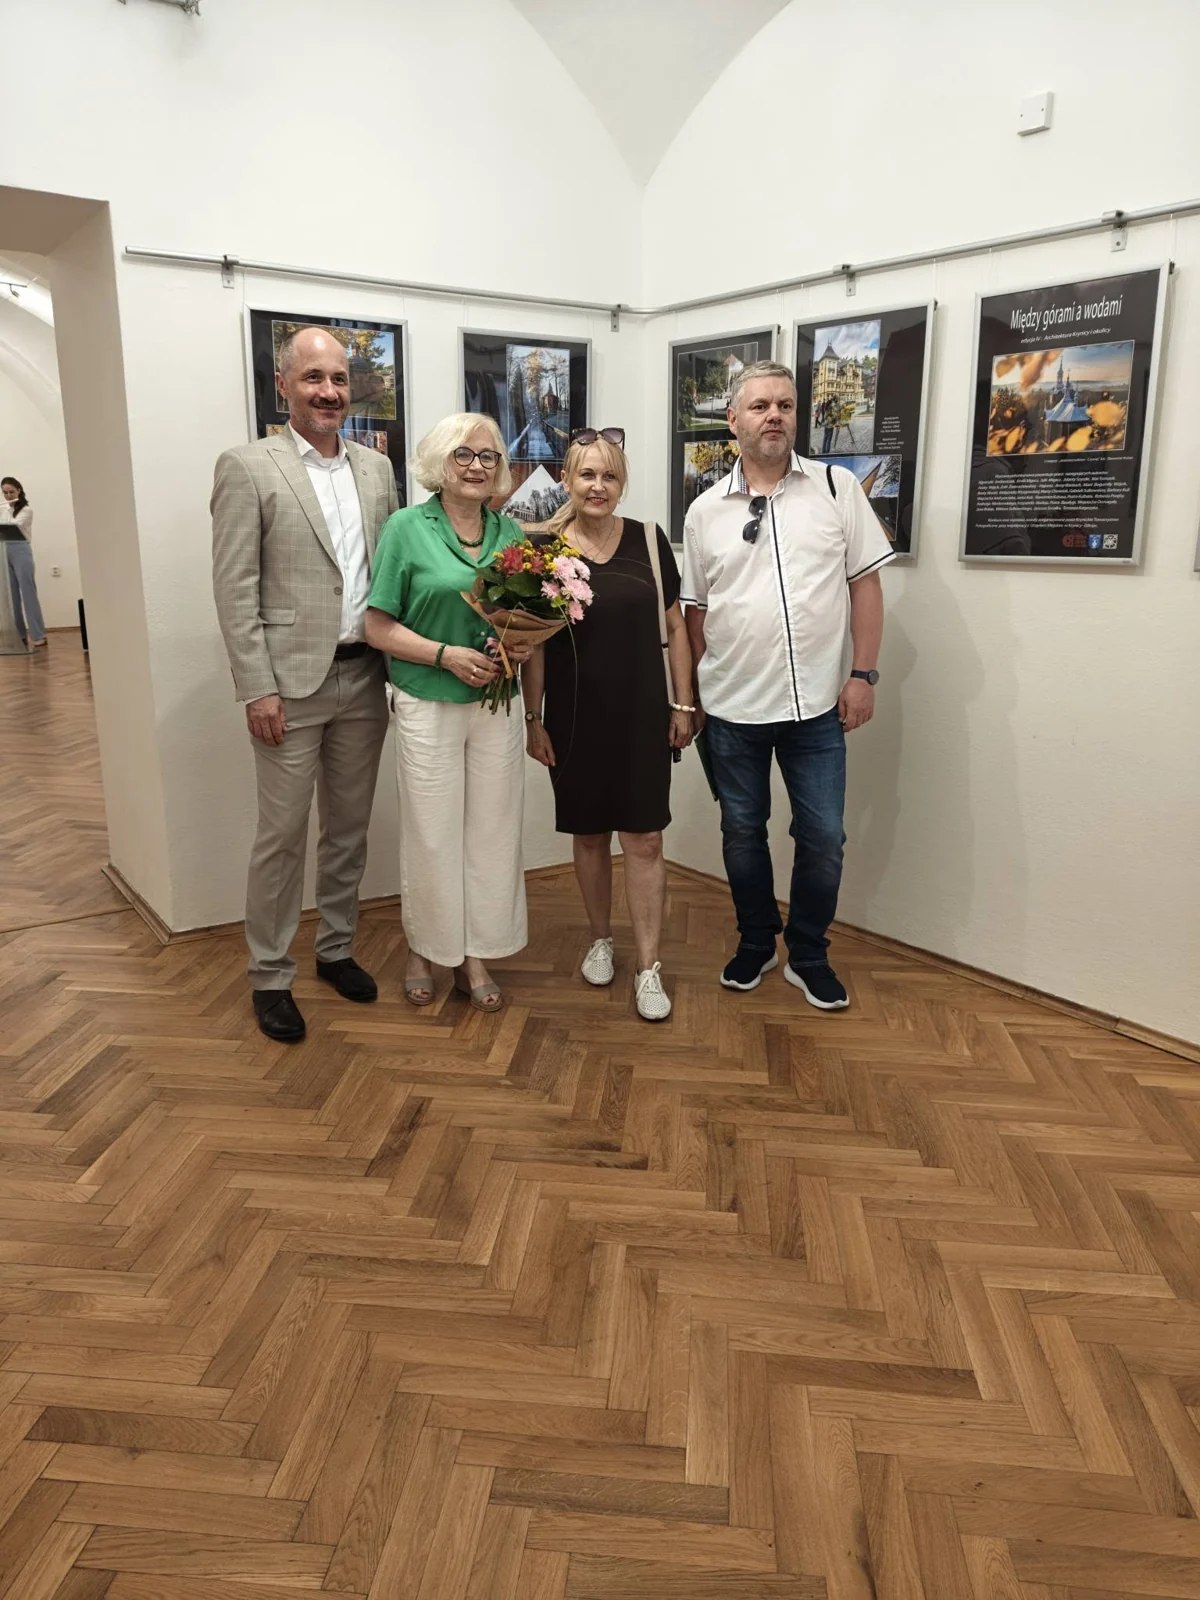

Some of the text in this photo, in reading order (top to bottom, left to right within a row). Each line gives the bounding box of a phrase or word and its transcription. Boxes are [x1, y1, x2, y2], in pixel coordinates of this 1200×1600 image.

[1010, 294, 1123, 333] Między górami a wodami
[1043, 333, 1072, 341] Architektura
[1071, 330, 1090, 338] Krynicy
[1092, 327, 1112, 335] okolicy
